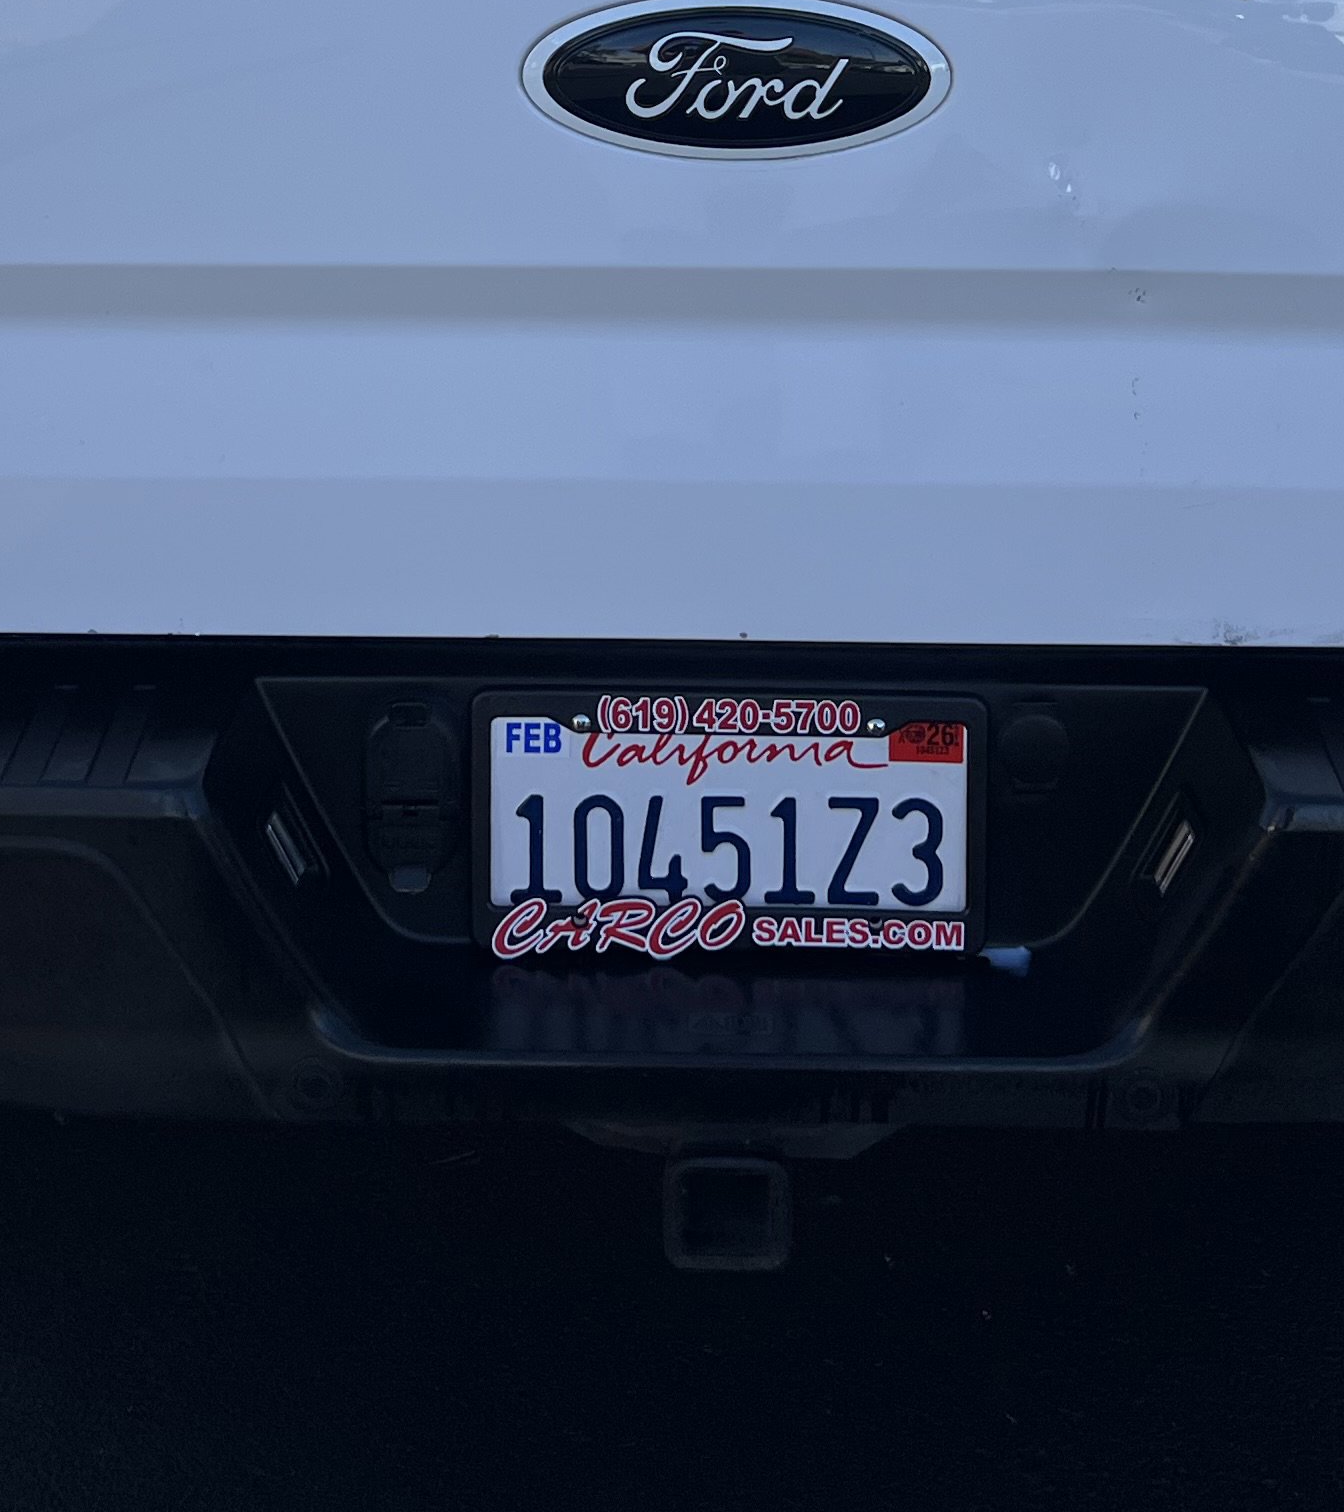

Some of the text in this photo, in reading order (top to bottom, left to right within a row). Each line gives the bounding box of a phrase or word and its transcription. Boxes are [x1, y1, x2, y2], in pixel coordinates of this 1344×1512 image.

[625, 31, 849, 120] Ford
[506, 722, 562, 754] FEB
[597, 695, 860, 734] (619) 420-5700
[582, 733, 888, 785] California
[510, 793, 944, 906] 10451Z3
[492, 898, 965, 959] CARCO SALES.COM
